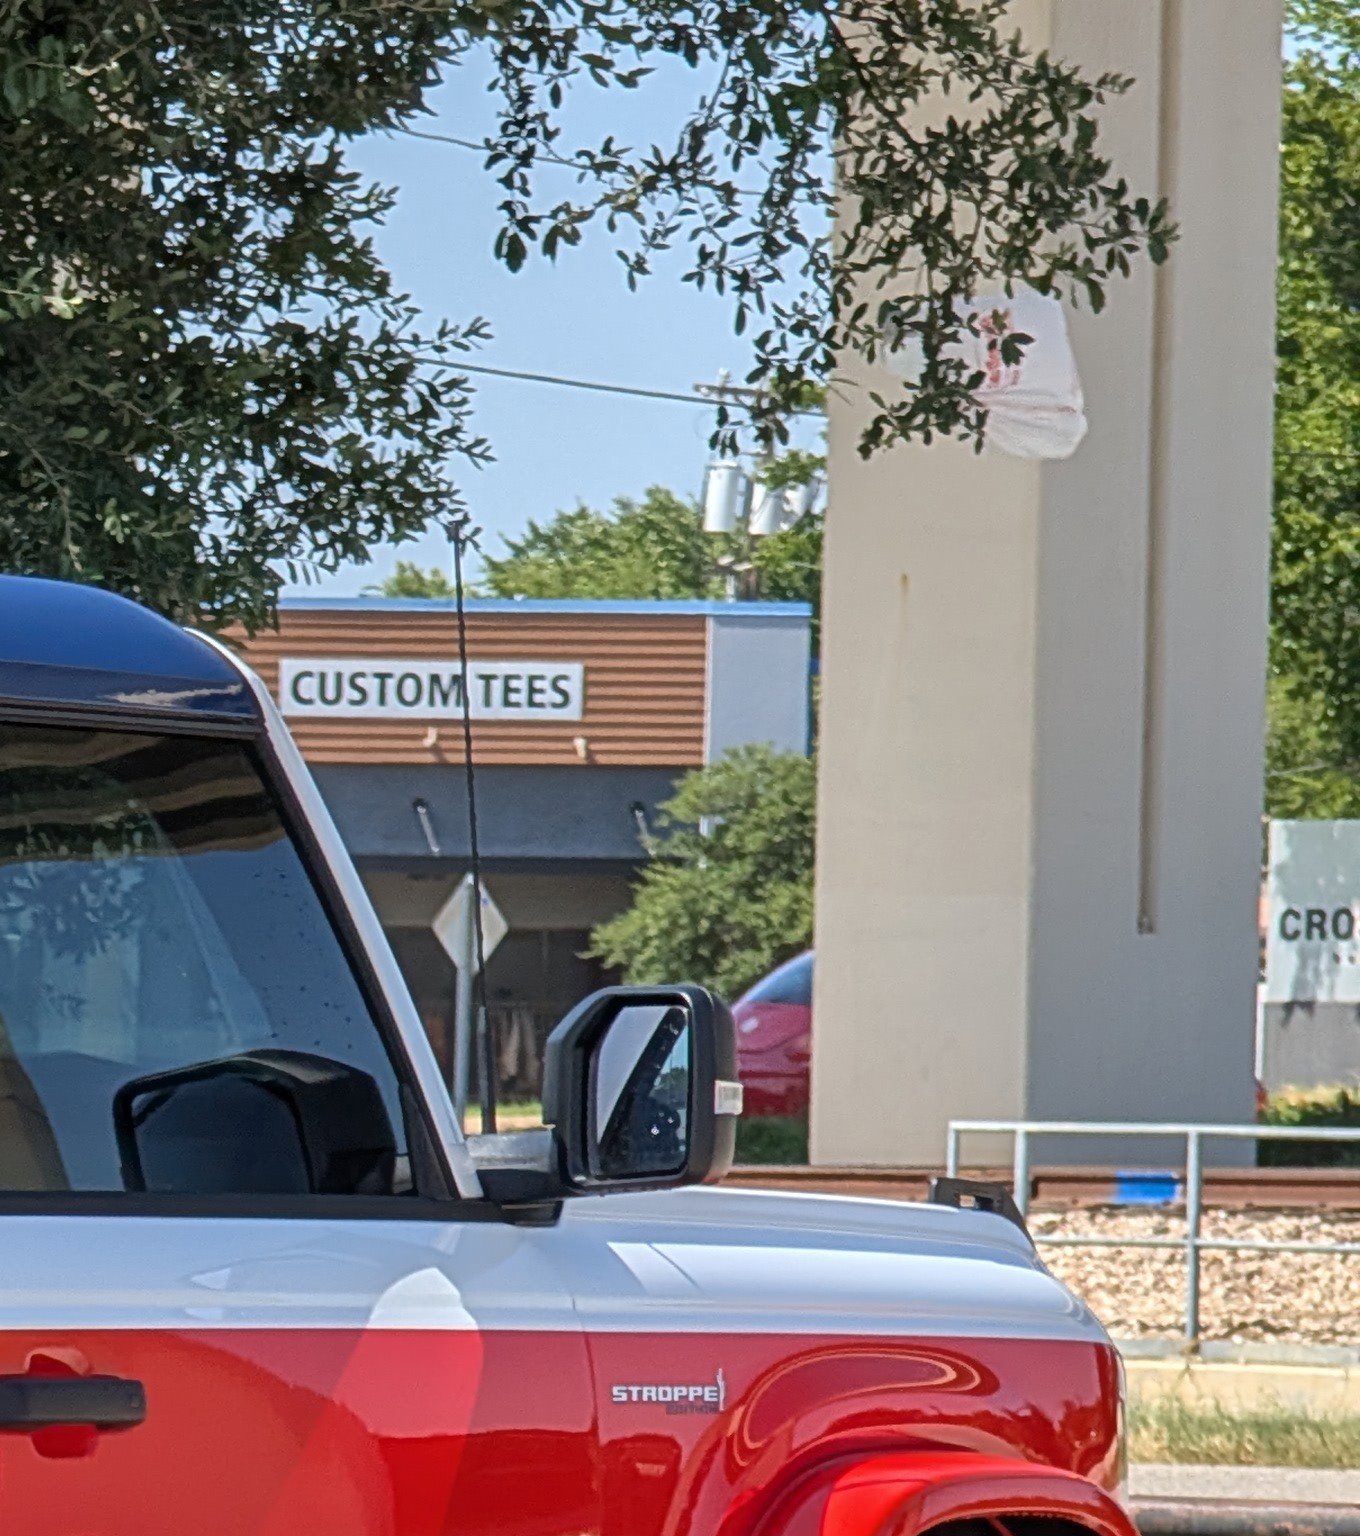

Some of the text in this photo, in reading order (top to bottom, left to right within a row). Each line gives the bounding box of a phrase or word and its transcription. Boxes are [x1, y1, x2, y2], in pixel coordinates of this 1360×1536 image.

[291, 670, 571, 711] CUSTOM TEES
[1280, 908, 1356, 941] CRO
